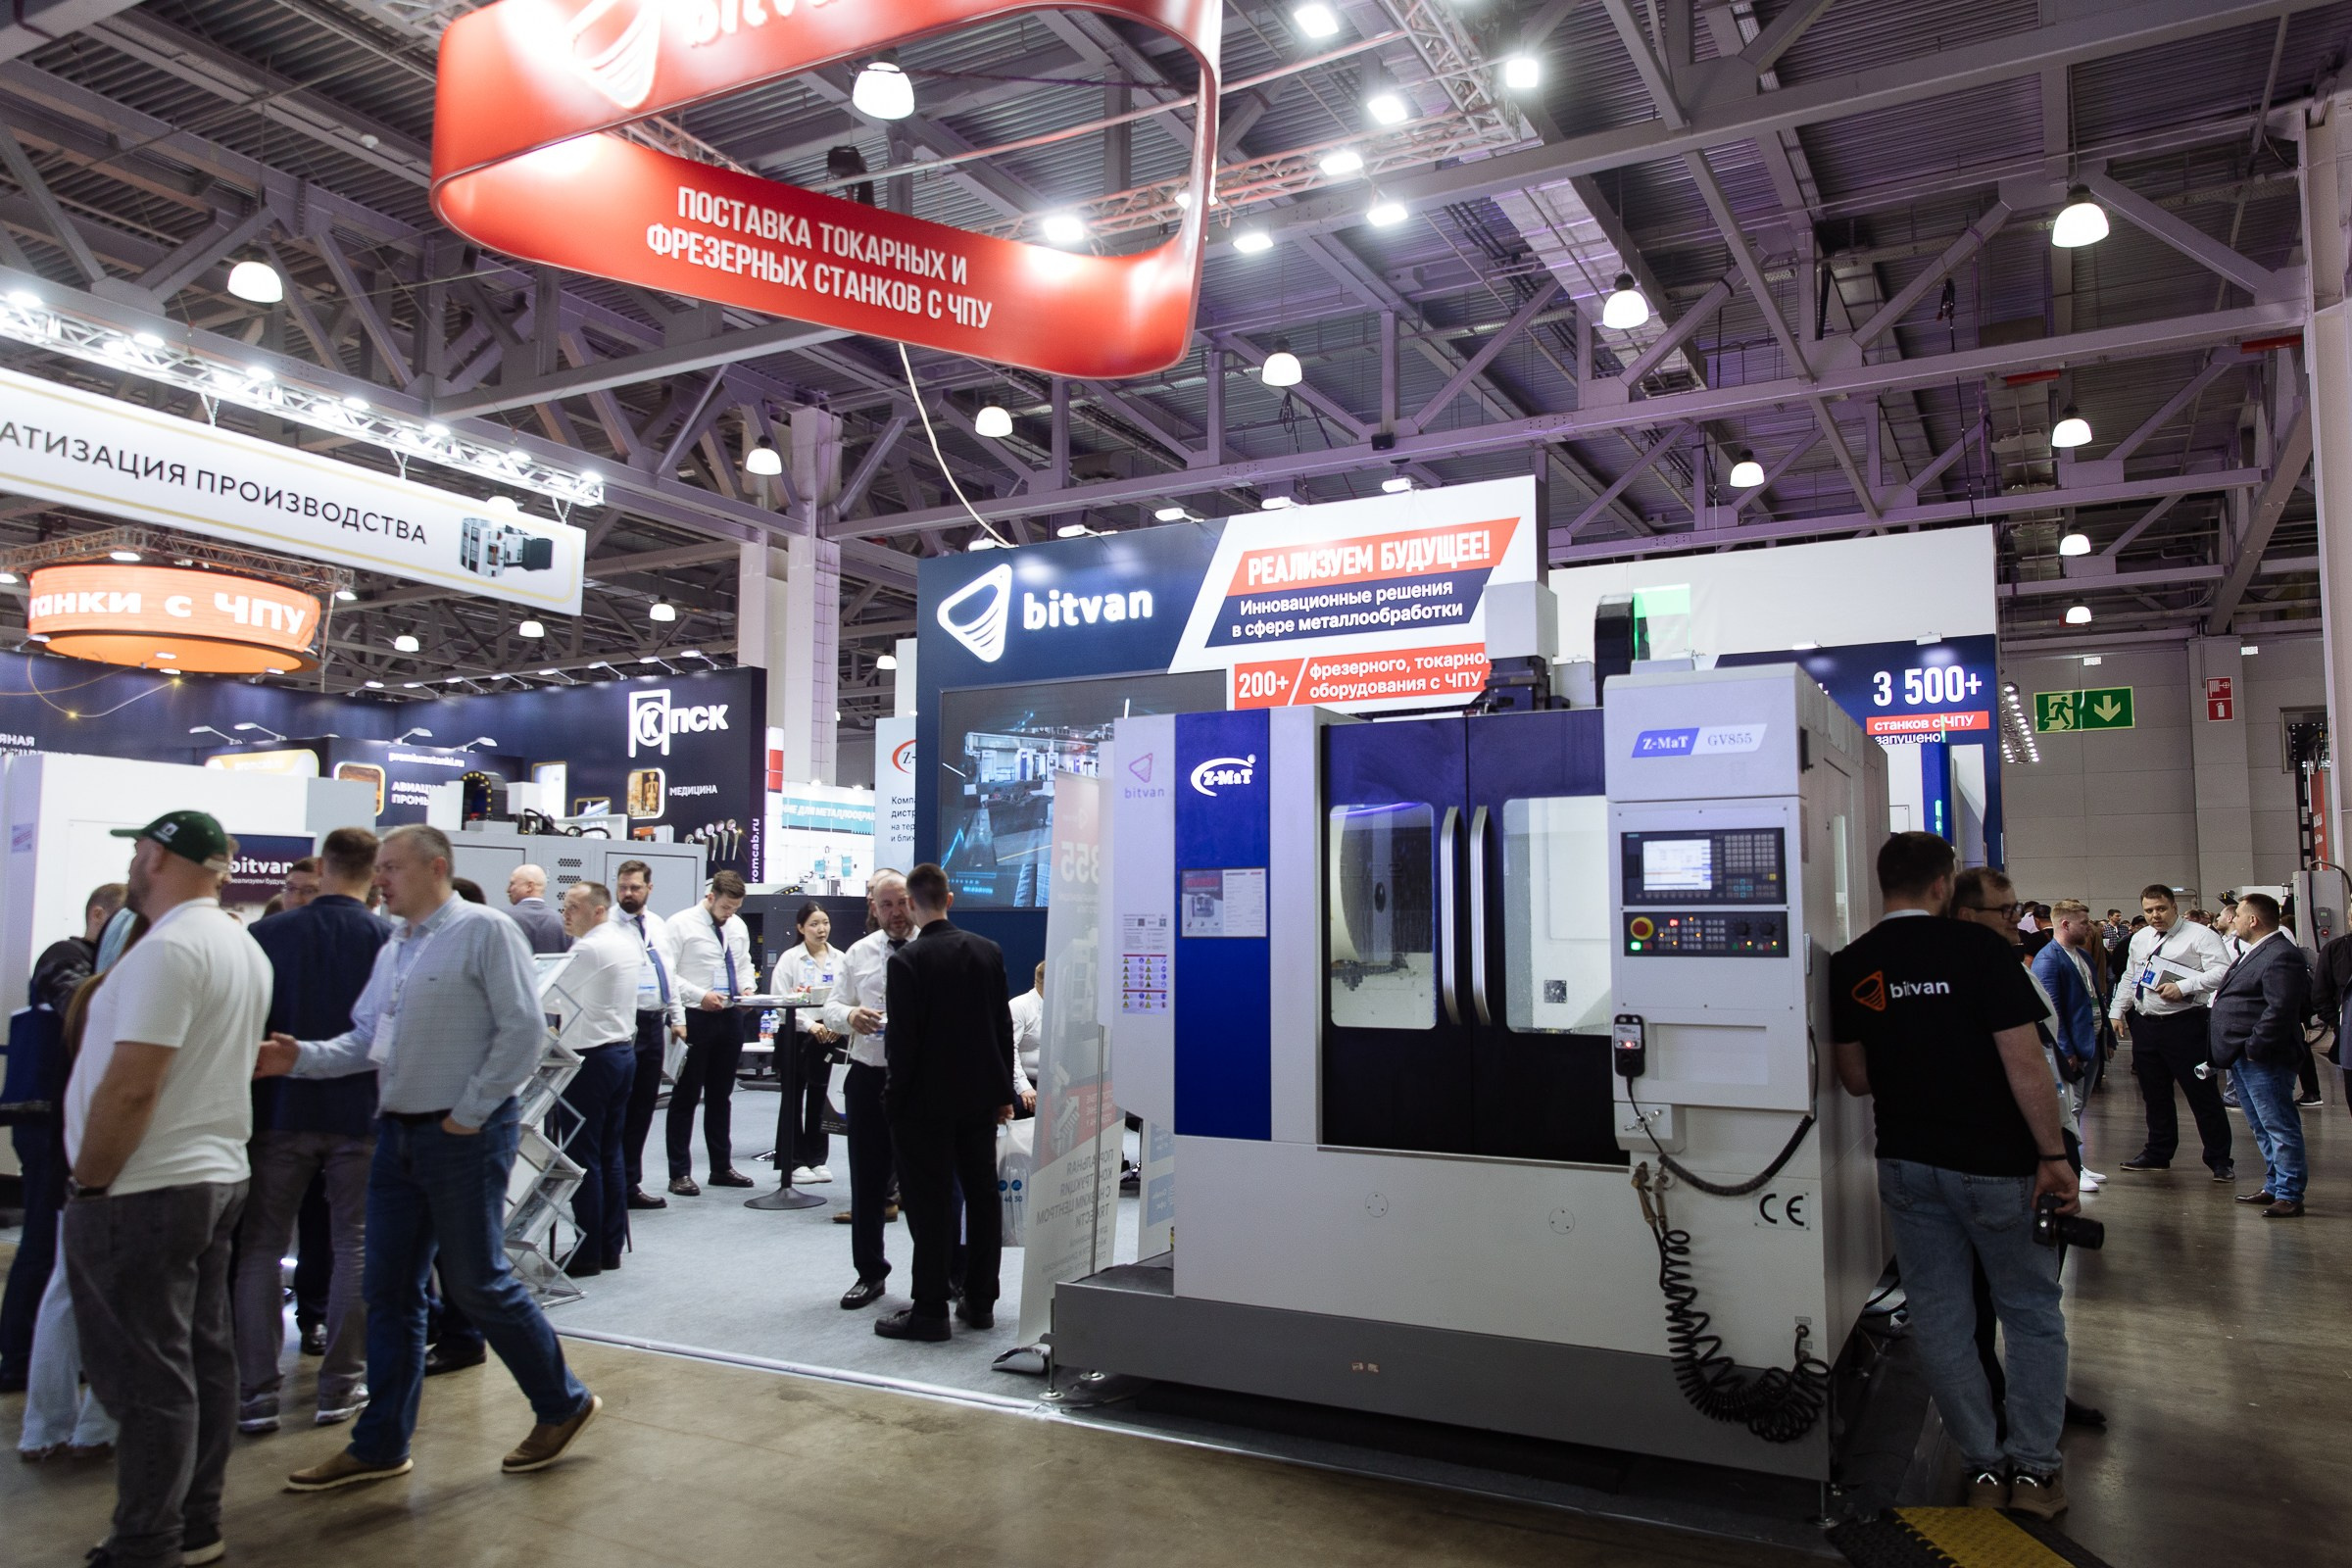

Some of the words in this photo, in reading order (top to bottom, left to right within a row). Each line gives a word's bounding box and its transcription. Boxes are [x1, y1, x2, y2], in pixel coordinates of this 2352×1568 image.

[677, 185, 812, 249] ПОСТАВКА
[818, 221, 947, 281] ТОКАРНЫХ
[952, 255, 967, 285] И
[646, 222, 808, 290] ФРЕЗЕРНЫХ
[813, 263, 921, 315] СТАНКОВ
[927, 289, 942, 319] С
[948, 293, 993, 329] ЧПУ
[0, 421, 186, 486] АТИЗАЦИЯ
[197, 469, 427, 544] ПРОИЗВОДСТВА
[1248, 544, 1373, 586] РЕАЛИЗУЕМ
[1381, 530, 1491, 571] БУДУЩЕЕ!
[1023, 589, 1152, 629] bitvan
[1240, 589, 1373, 615] Инновационные
[1376, 581, 1453, 605] решения
[30, 592, 142, 619] танки
[165, 595, 192, 617] с
[213, 592, 306, 635] ЧПУ
[1232, 625, 1242, 637] в
[1245, 618, 1295, 638] сфере
[1298, 603, 1463, 631] металлообработки
[1309, 659, 1410, 680] фрезерного,
[1414, 652, 1490, 672] токарно
[1238, 670, 1290, 698] 200+
[1309, 676, 1426, 700] оборудования
[1430, 675, 1441, 688] с
[1445, 670, 1483, 688] ЧПУ
[1873, 670, 1892, 707] 3
[1904, 665, 1983, 705] 500+
[669, 705, 729, 734] ПСК
[1874, 718, 1929, 731] станков
[1933, 718, 1940, 728] с
[1943, 714, 1975, 728] ЧПУ
[0, 733, 35, 747] ЯНАЯ
[1642, 735, 1689, 750] Z-MaT
[1707, 732, 1752, 746] GV855
[391, 781, 435, 795] АВИАЦ
[669, 785, 718, 797] МЕДИЦИНА
[1124, 787, 1164, 799] bitvan
[815, 807, 875, 821] МЕТАЛЛООБРАБ
[891, 809, 915, 819] дистр
[751, 818, 760, 883] romcab.ru
